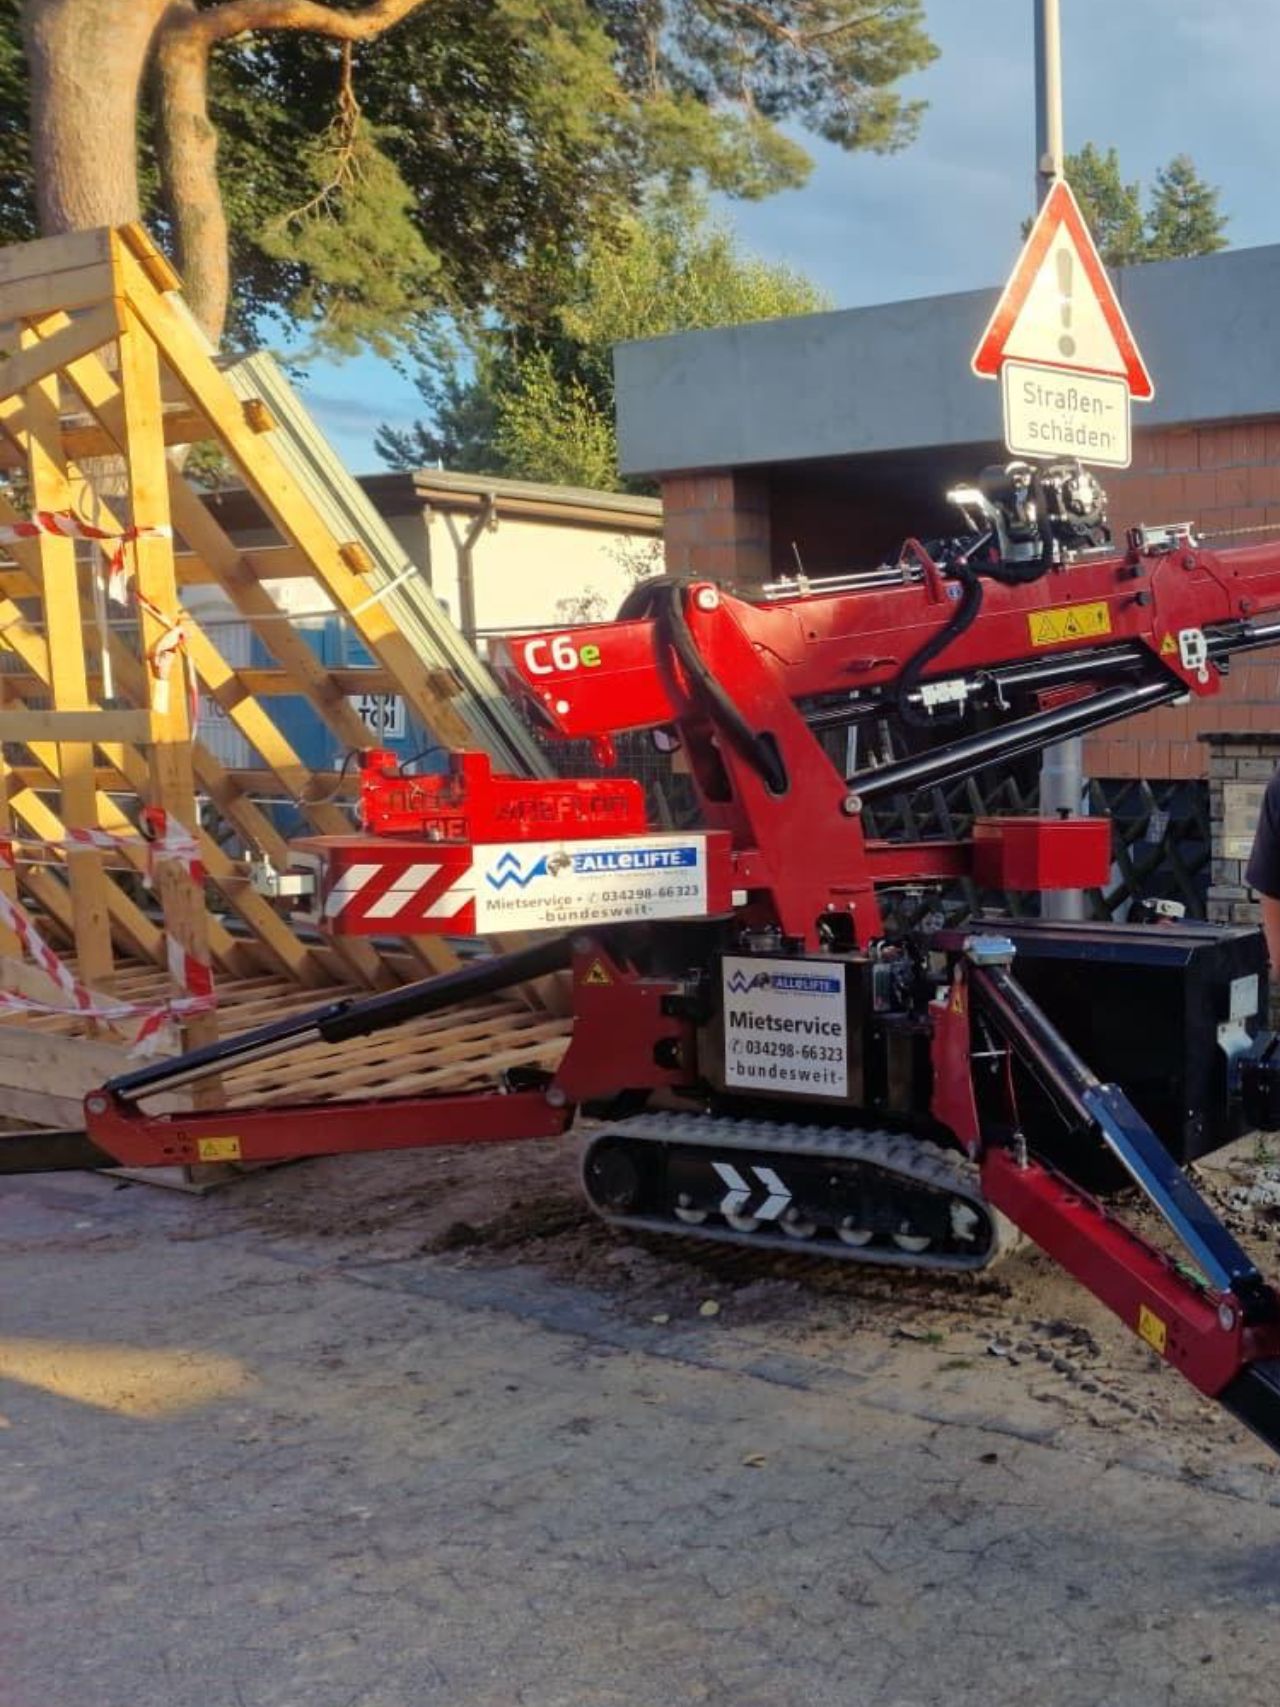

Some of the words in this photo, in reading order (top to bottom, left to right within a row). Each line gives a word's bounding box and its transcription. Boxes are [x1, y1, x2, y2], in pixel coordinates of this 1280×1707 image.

[1023, 381, 1114, 415] Straßen-
[1028, 419, 1111, 449] schäden
[524, 636, 602, 675] C6e
[358, 707, 396, 729] TOI
[486, 893, 573, 911] Mietservice
[601, 884, 699, 902] 034298-66323
[729, 1010, 842, 1037] Mietservice
[745, 1039, 843, 1062] 034298-66323
[729, 1061, 844, 1085] -bundesweit-
